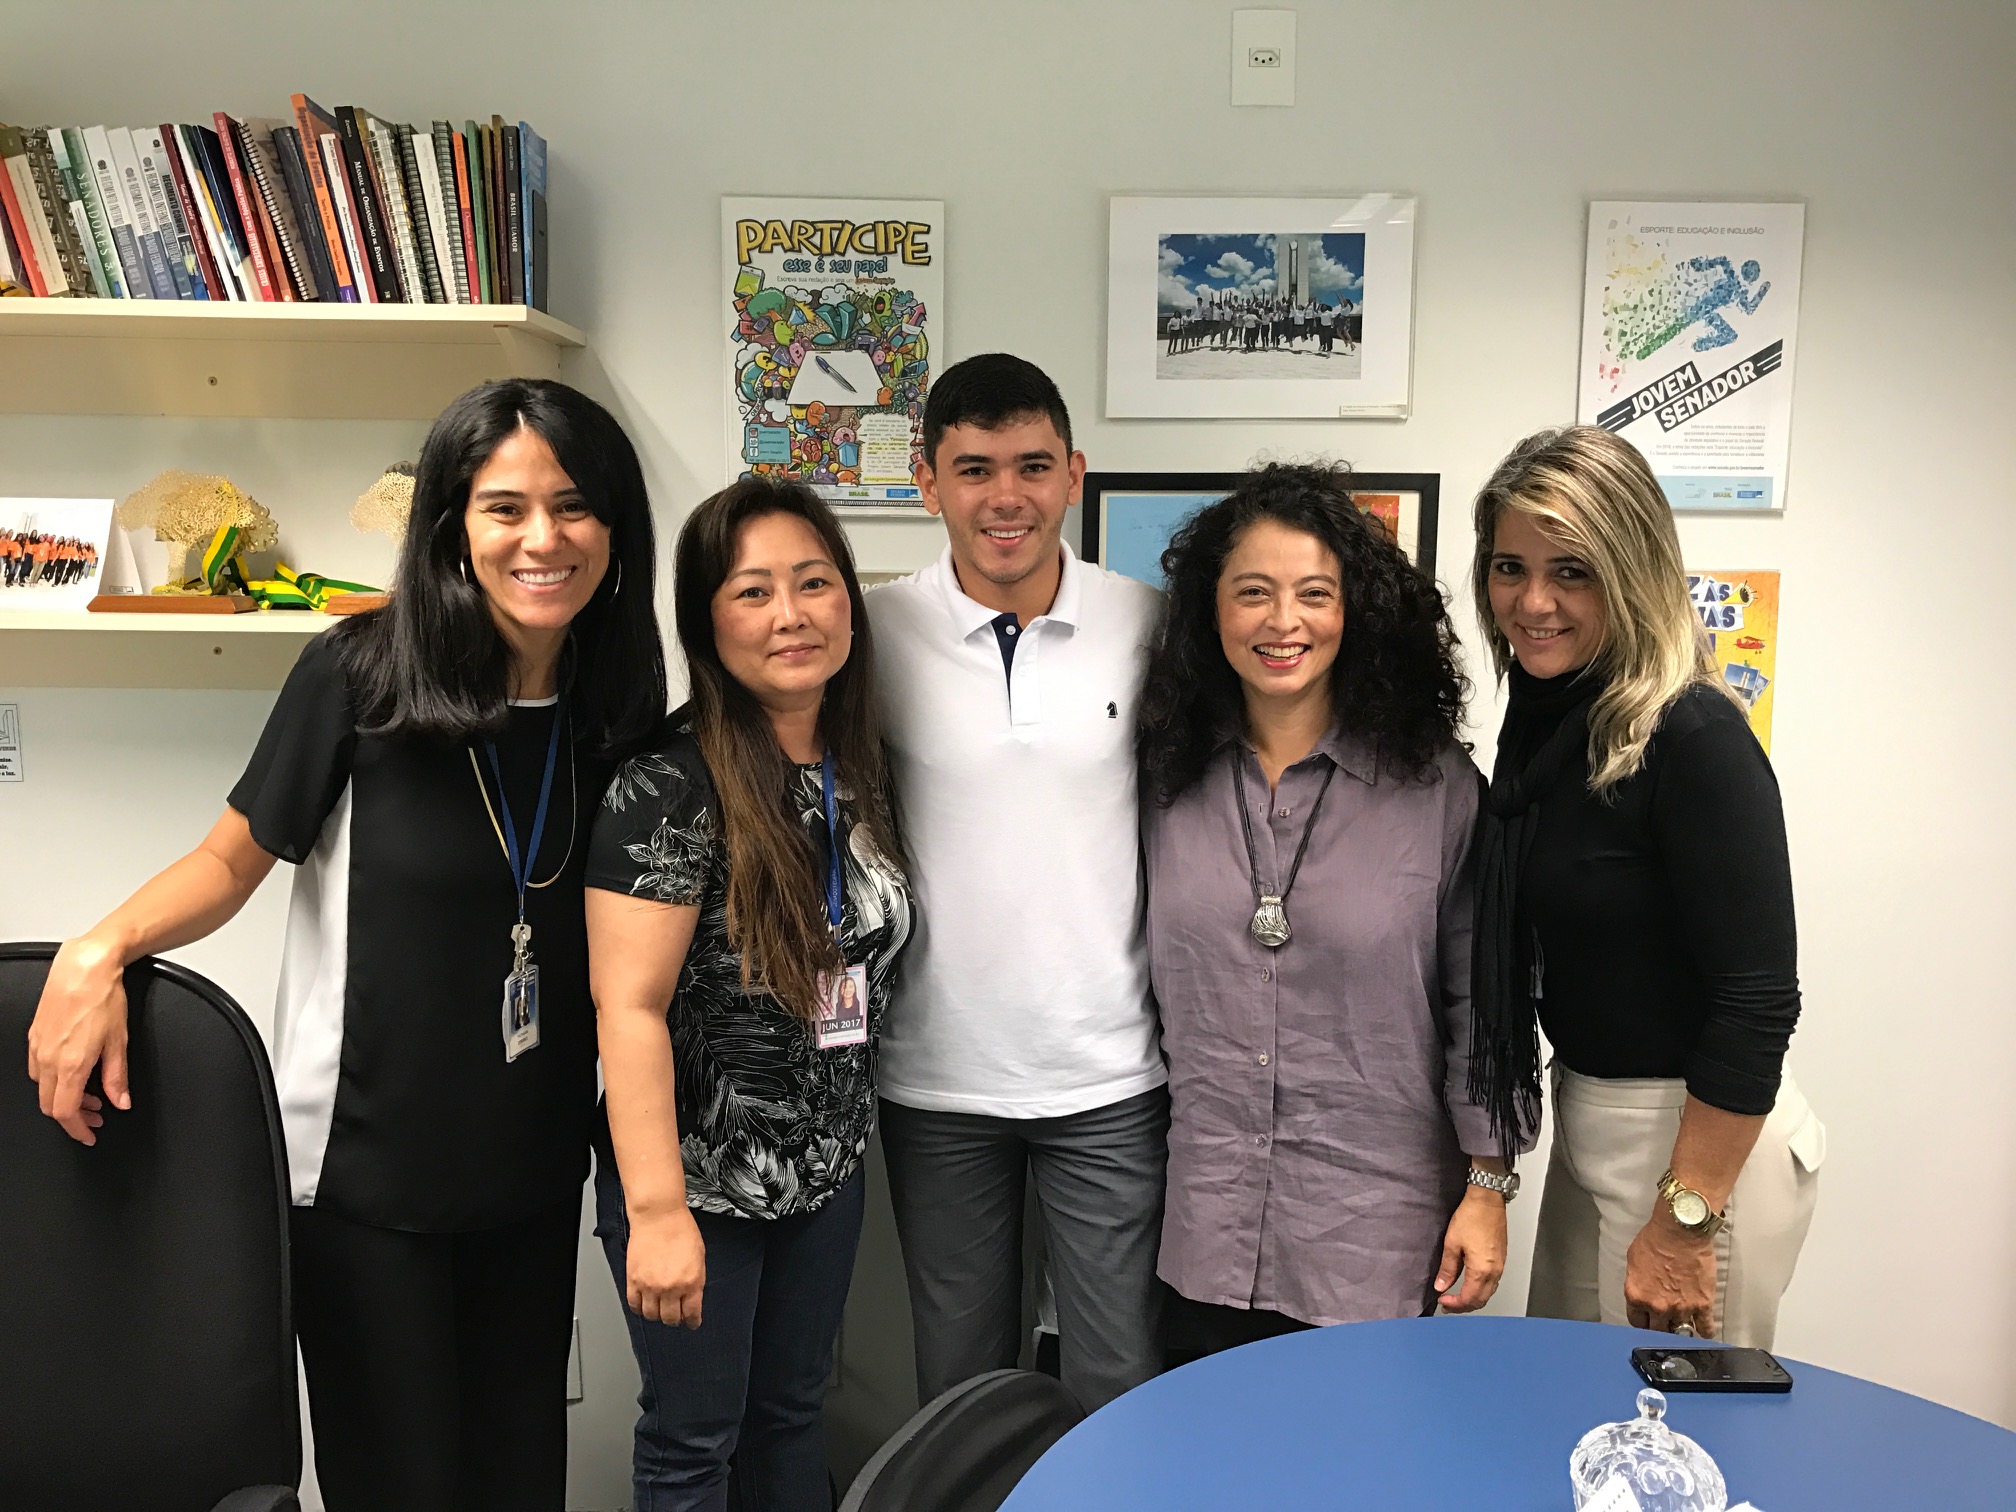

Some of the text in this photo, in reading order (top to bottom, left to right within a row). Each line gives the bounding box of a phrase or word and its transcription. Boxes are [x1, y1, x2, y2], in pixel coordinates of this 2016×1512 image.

[311, 161, 324, 189] Eventos
[77, 172, 110, 256] SENADORES
[162, 174, 187, 233] REGIMENTO COMUM
[736, 219, 931, 266] PARTICIPE
[1676, 226, 1719, 235] EDUCAÇÃO
[1727, 226, 1765, 235] INCLUSÃO
[776, 275, 797, 283] Escreva
[783, 255, 888, 277] esse é seu papel
[1630, 364, 1699, 419] JOVEM
[1660, 361, 1758, 430] SENADOR
[822, 1018, 861, 1033] JUN 2017
